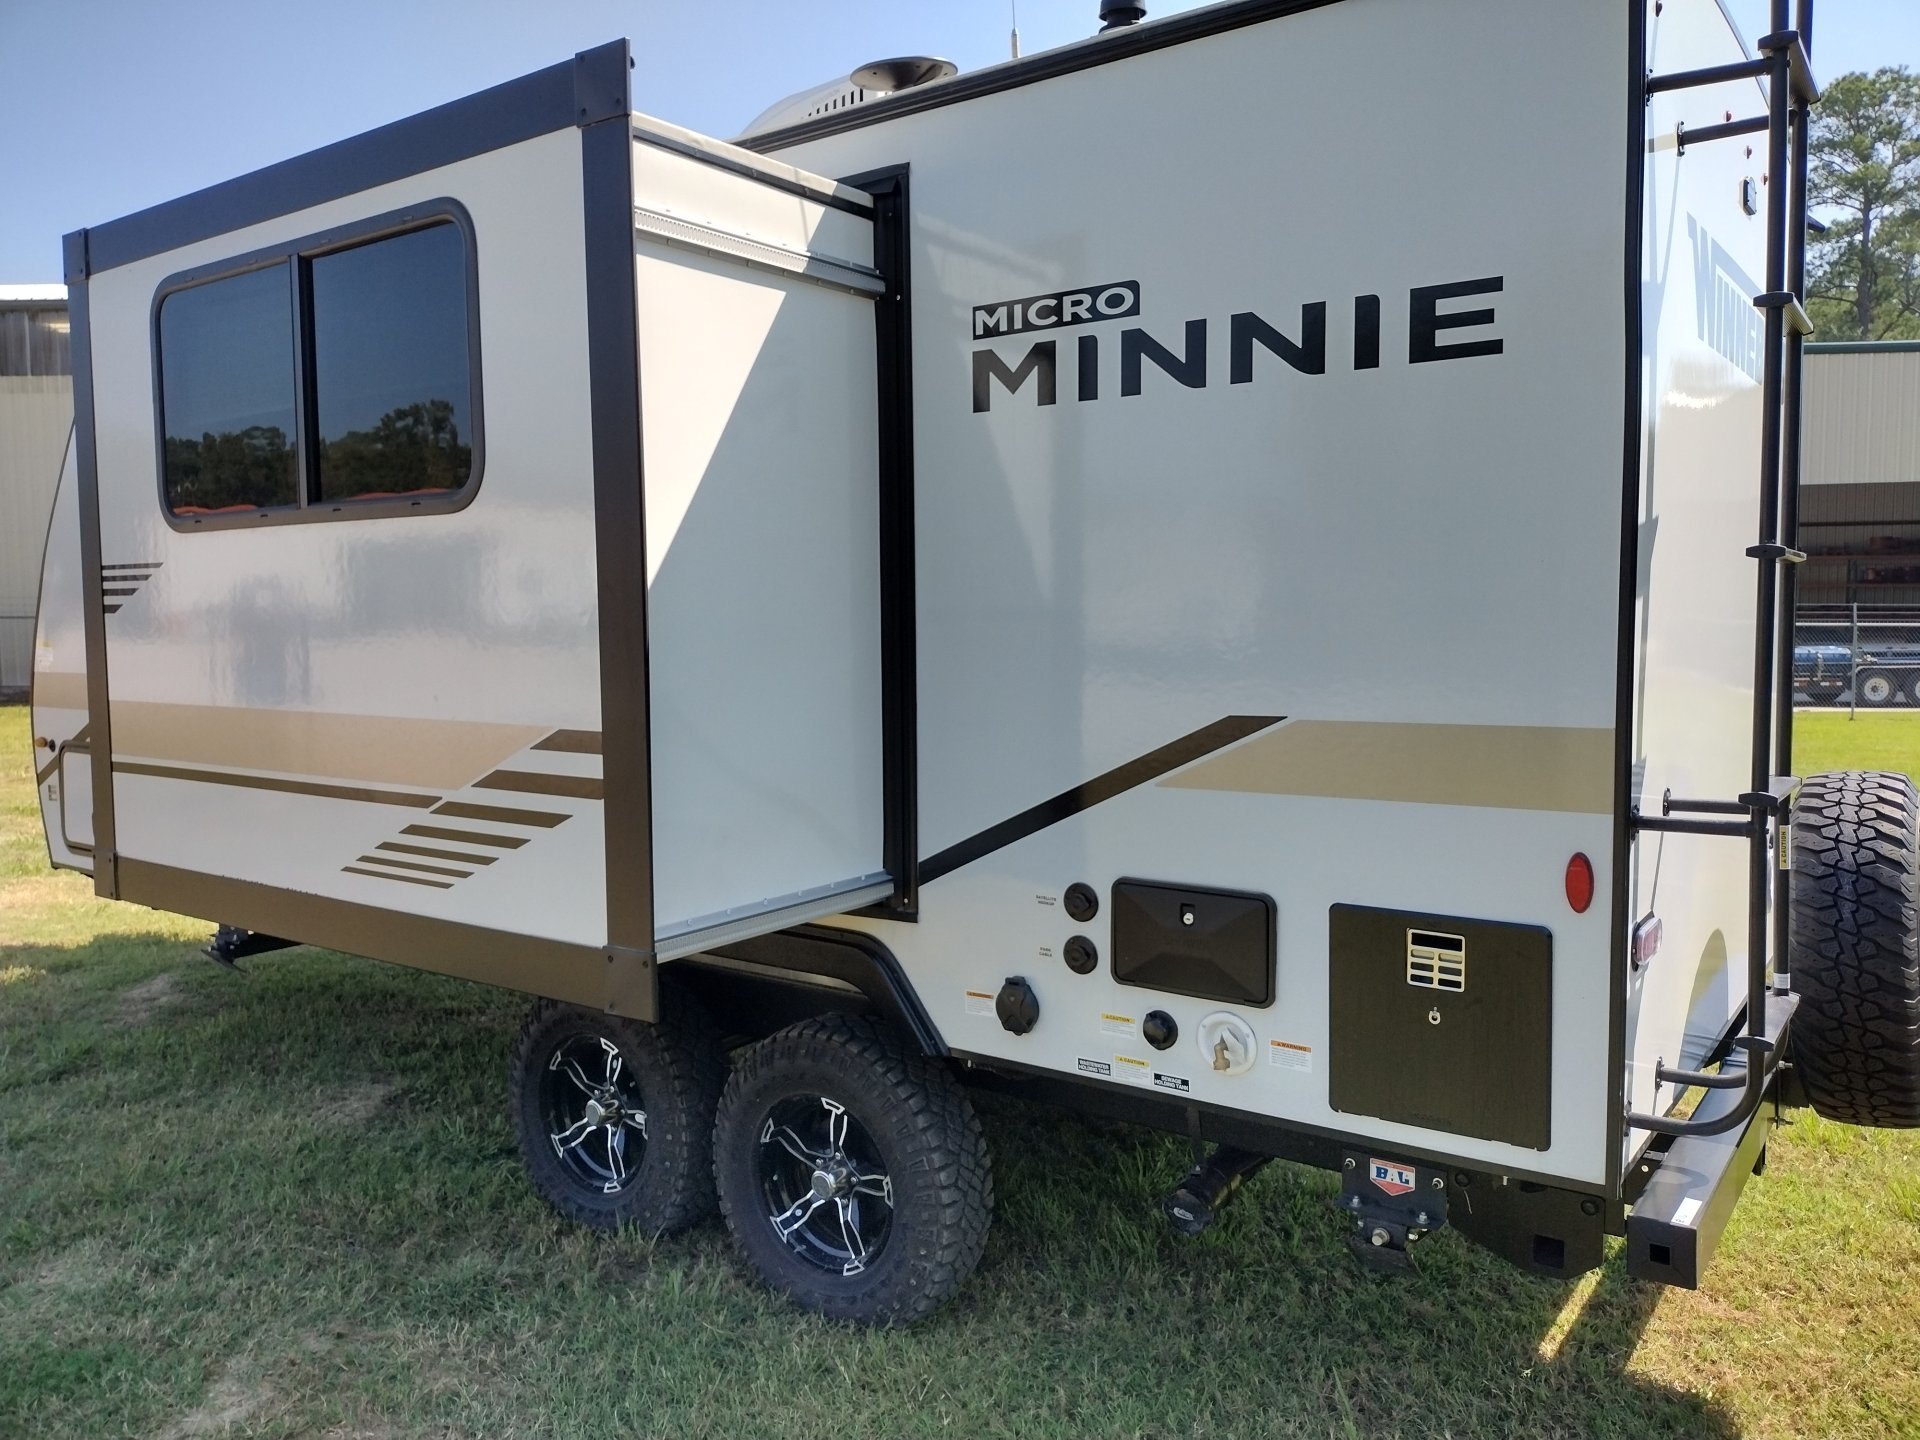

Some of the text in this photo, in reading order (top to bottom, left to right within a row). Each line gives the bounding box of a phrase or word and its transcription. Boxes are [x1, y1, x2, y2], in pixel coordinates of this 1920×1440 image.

[974, 286, 1135, 336] MICRO
[972, 276, 1504, 413] MINNIE
[1123, 1057, 1145, 1066] CAUTION
[1280, 1042, 1307, 1052] WARNING
